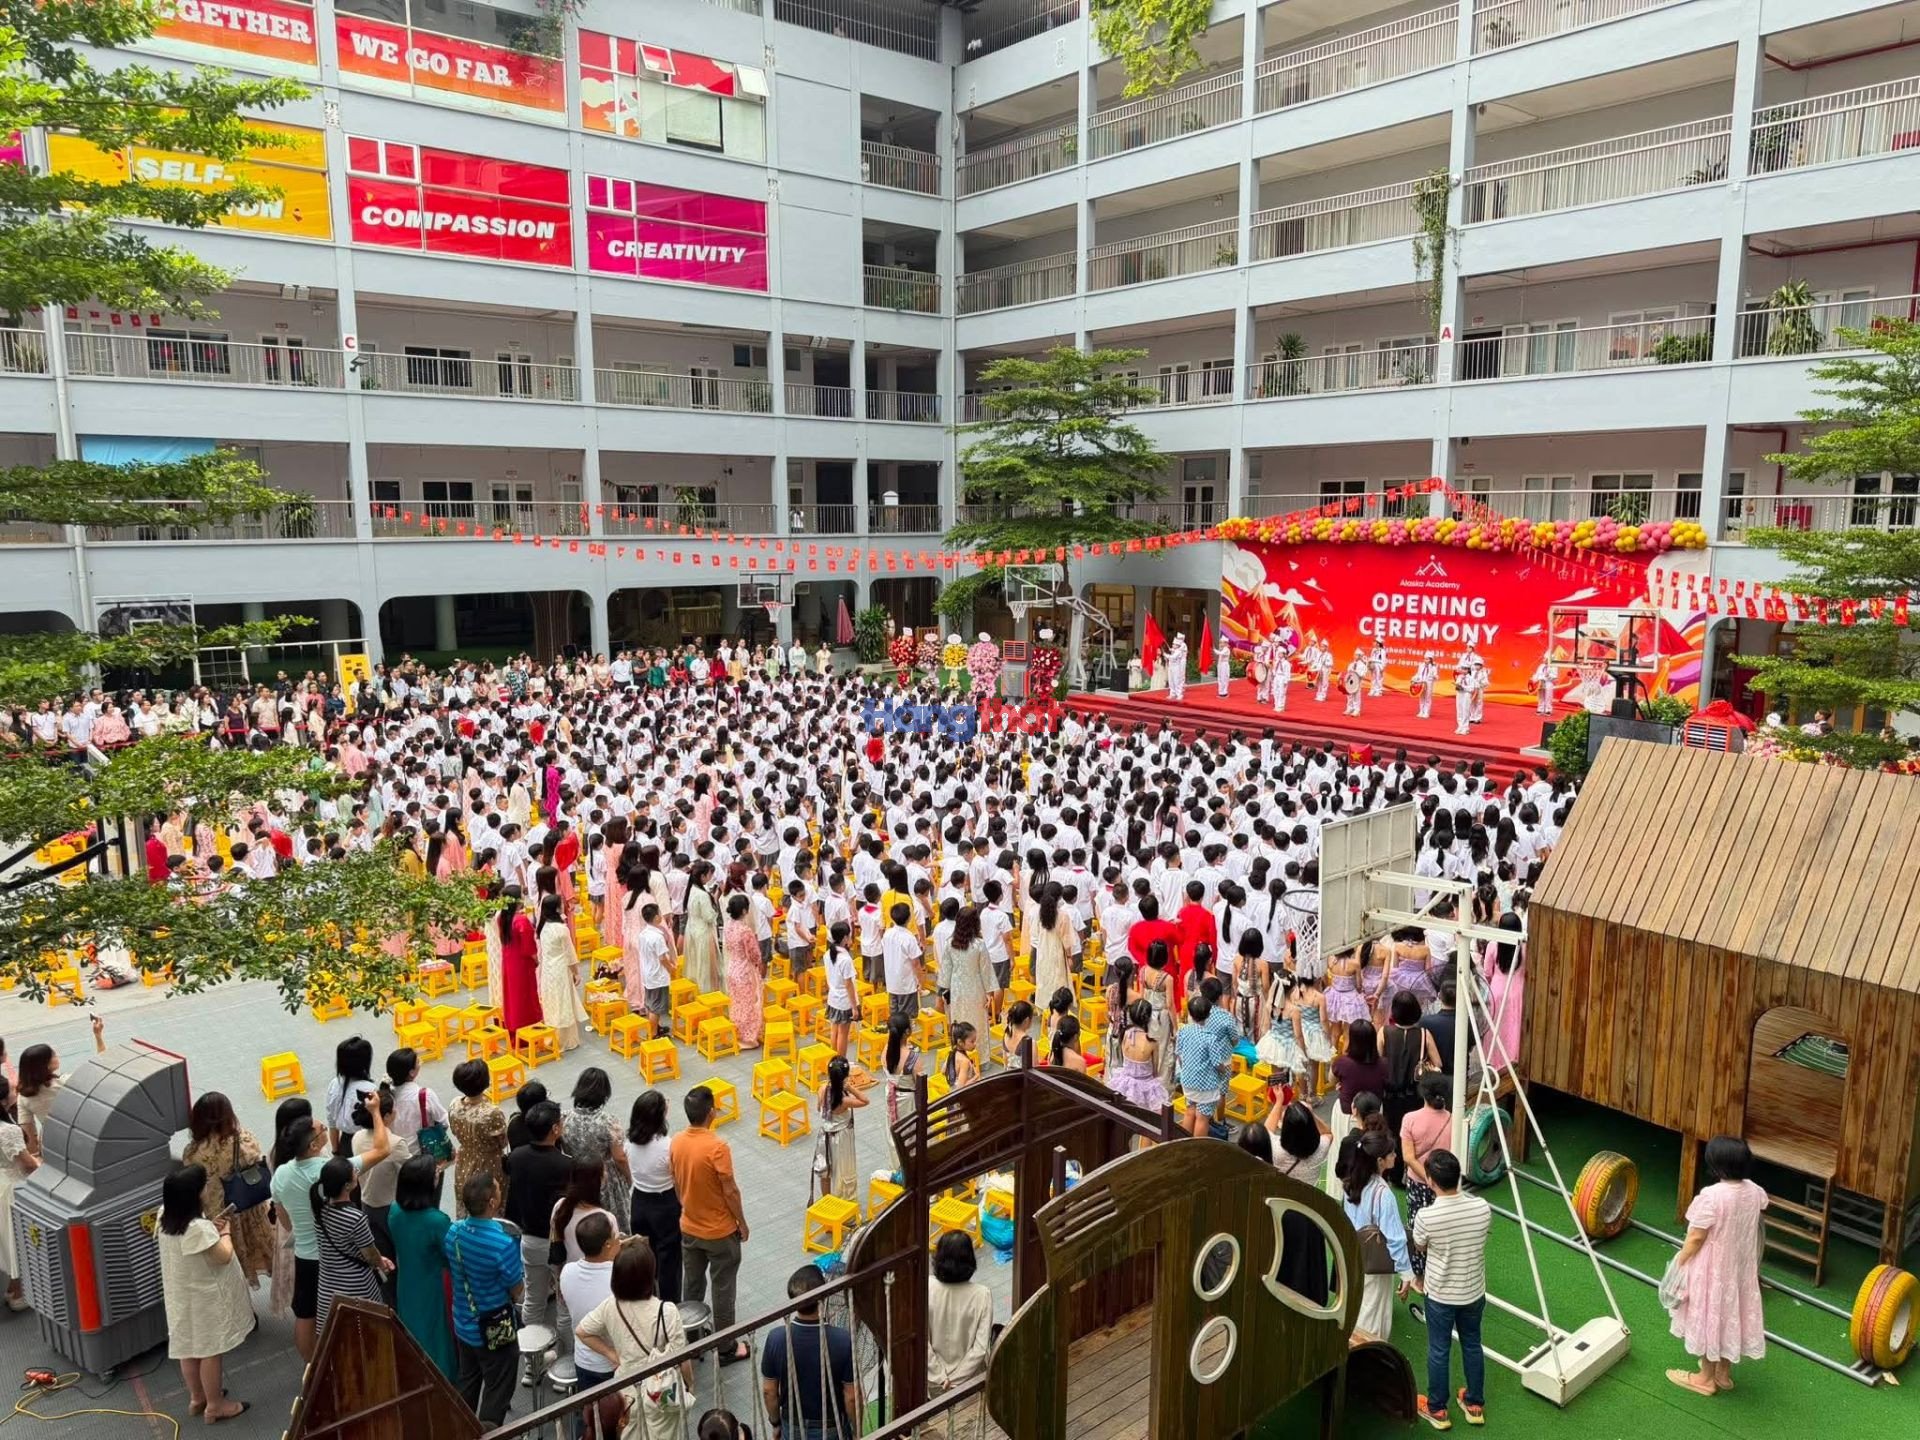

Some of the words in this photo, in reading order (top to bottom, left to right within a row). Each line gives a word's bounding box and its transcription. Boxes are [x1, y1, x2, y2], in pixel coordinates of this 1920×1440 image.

[351, 31, 399, 64] WE
[405, 48, 450, 75] GO
[456, 57, 512, 87] FAR
[137, 157, 235, 184] SELF-
[361, 206, 555, 239] COMPASSION
[607, 239, 746, 263] CREATIVITY
[345, 336, 355, 349] C
[1441, 326, 1451, 339] A
[1400, 579, 1424, 588] Alaska
[1425, 580, 1460, 591] Academy
[1372, 592, 1487, 618] OPENING
[1358, 616, 1500, 645] CEREMONY
